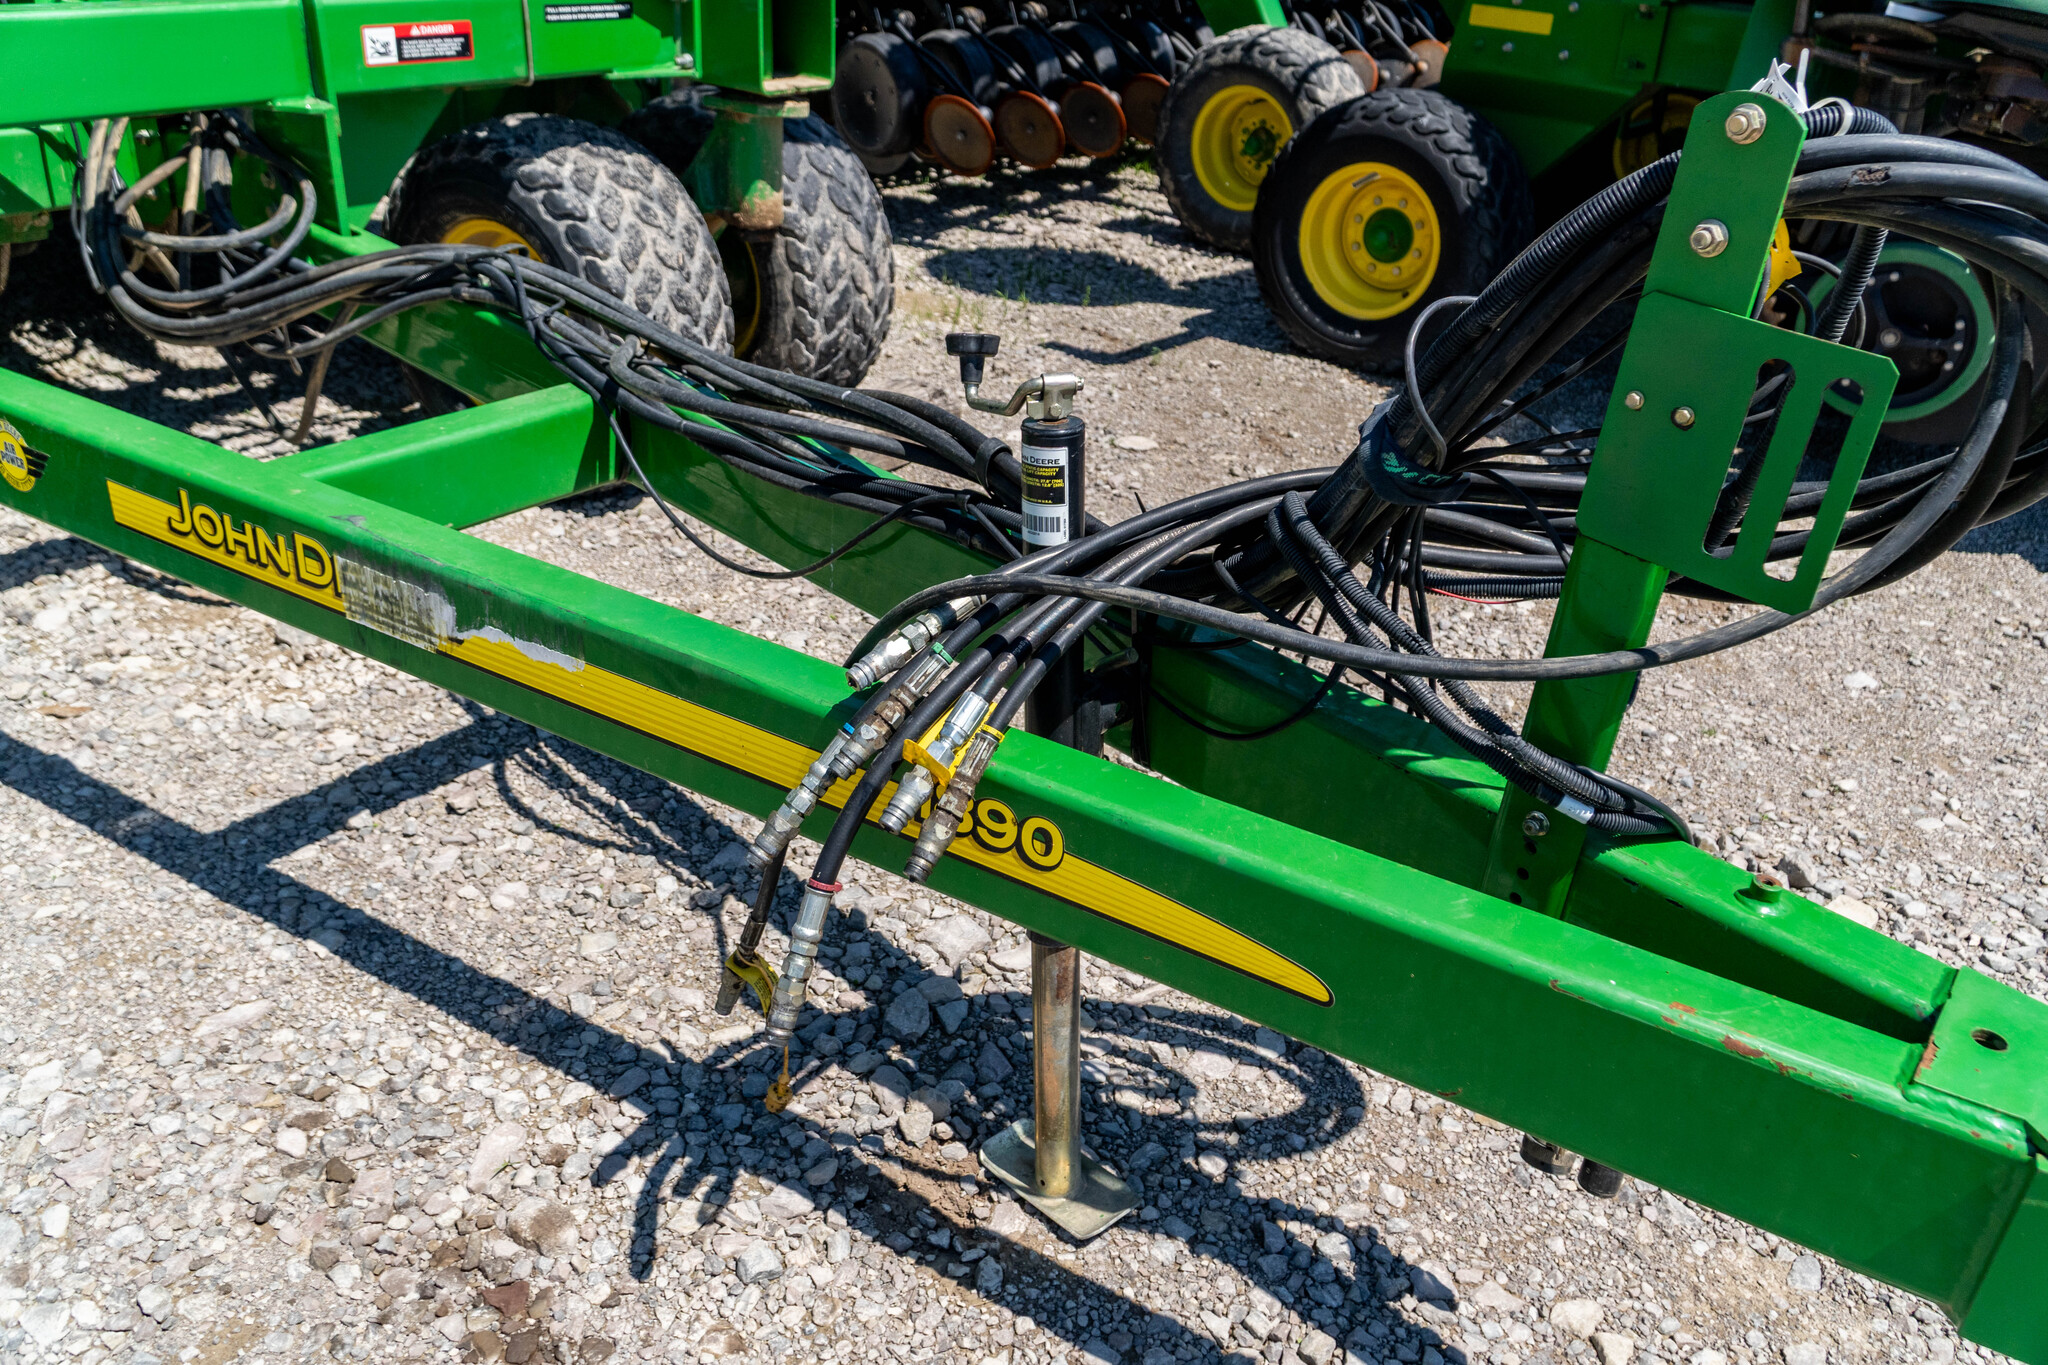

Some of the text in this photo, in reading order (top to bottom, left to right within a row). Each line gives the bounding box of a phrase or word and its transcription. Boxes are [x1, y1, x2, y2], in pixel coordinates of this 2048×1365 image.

[420, 24, 455, 35] DANGER
[4, 441, 17, 456] AIR
[1, 450, 26, 470] POWER
[1030, 456, 1060, 465] DEERE
[168, 487, 343, 599] JOHN D
